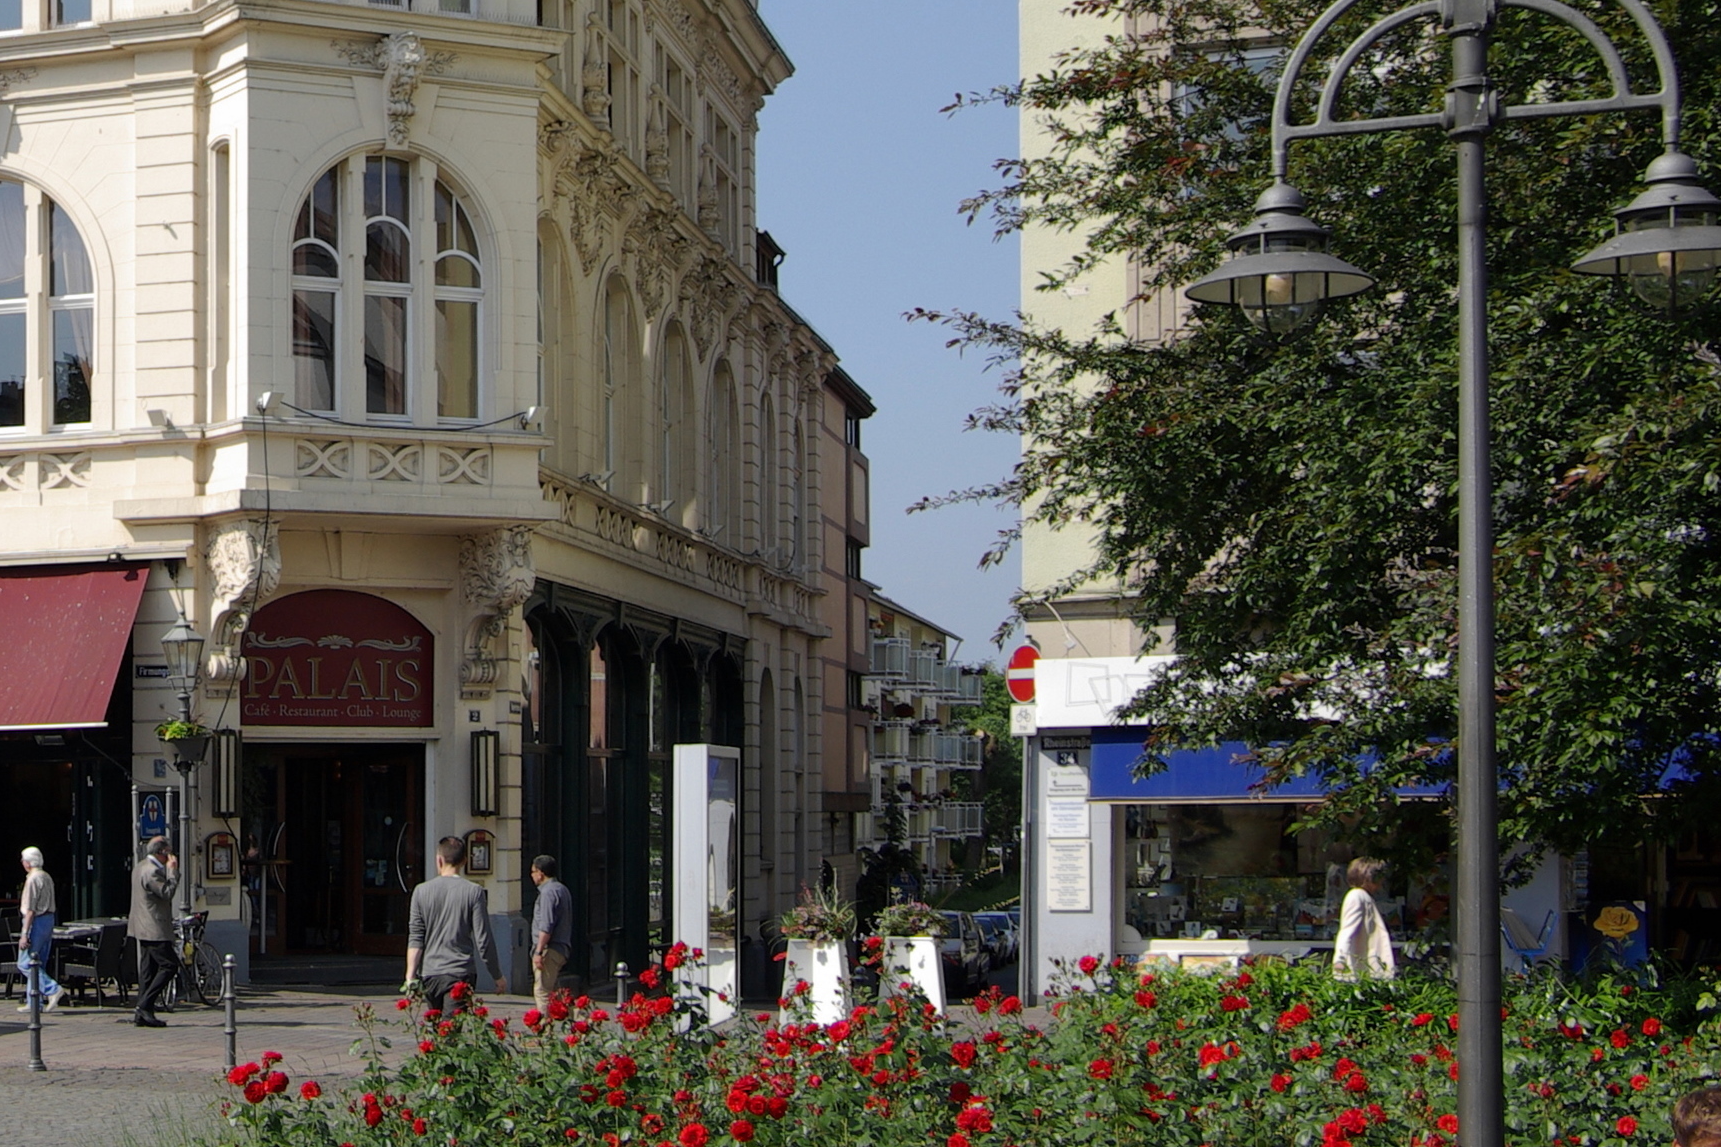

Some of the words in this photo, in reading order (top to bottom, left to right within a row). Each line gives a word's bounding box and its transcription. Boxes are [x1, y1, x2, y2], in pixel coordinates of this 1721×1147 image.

[244, 655, 422, 702] PALAIS
[244, 704, 271, 717] Café
[279, 704, 339, 718] Restaurant
[346, 704, 374, 718] Club
[382, 705, 422, 722] Lounge
[1059, 752, 1076, 765] 34
